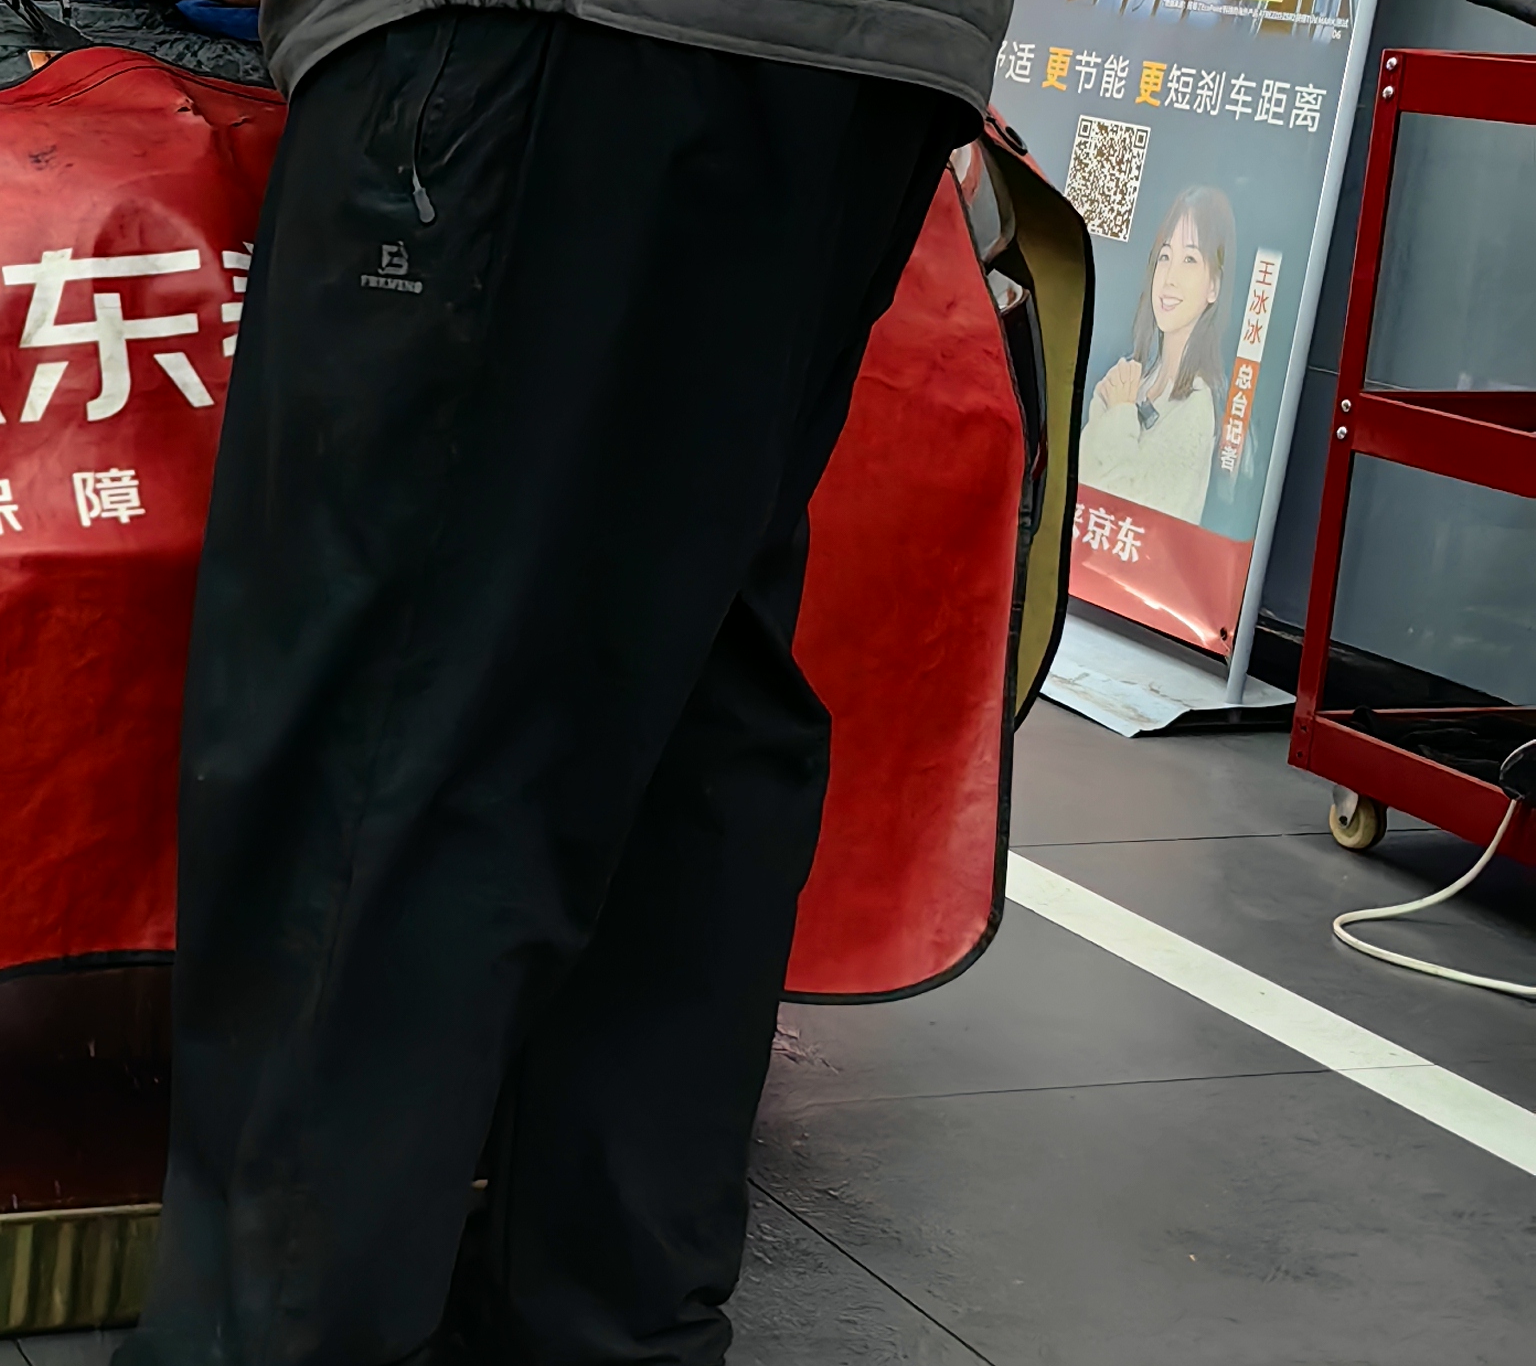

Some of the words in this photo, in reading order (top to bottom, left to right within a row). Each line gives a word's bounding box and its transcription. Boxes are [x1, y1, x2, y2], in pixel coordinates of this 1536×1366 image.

[1041, 46, 1130, 99] 更节能
[1135, 60, 1327, 133] 更短刹车距离
[1243, 260, 1275, 345] 王冰冰
[1220, 364, 1253, 472] 总台记者
